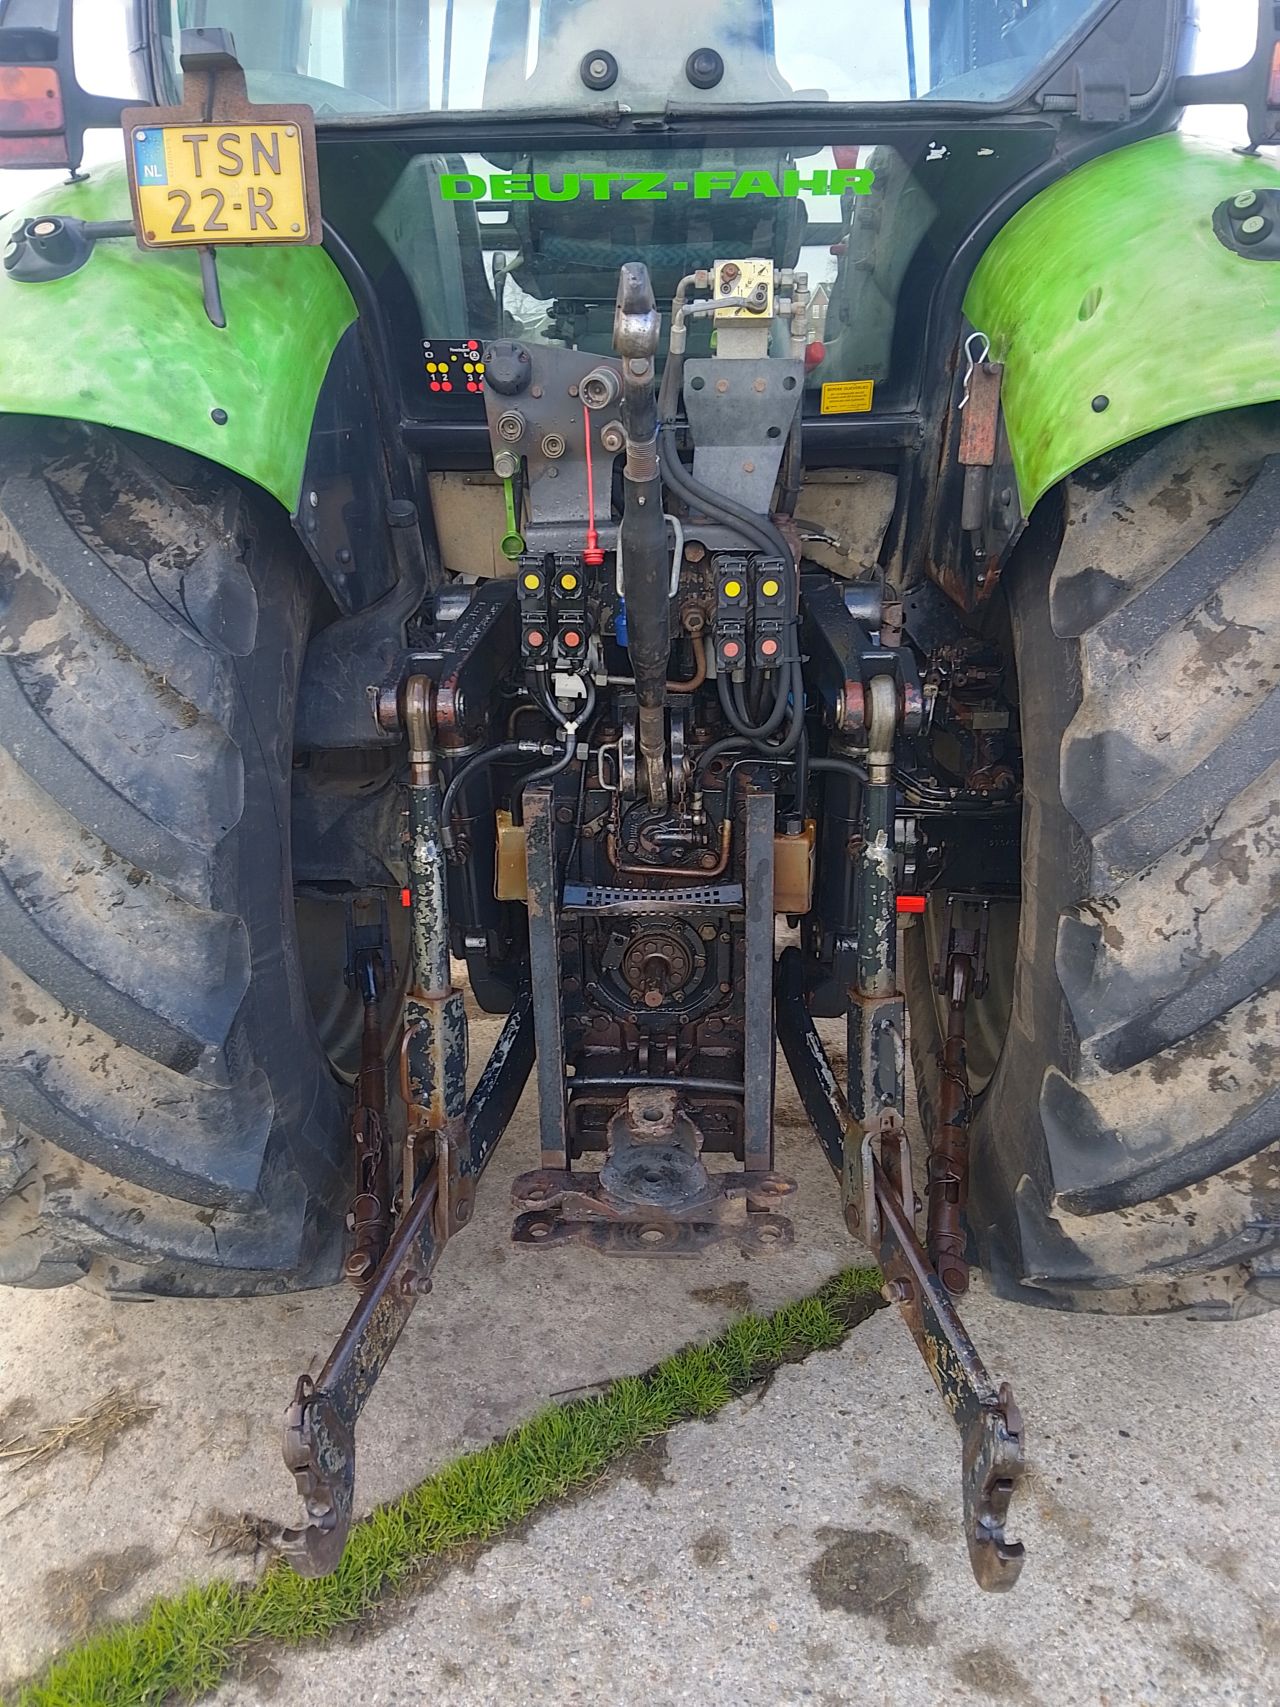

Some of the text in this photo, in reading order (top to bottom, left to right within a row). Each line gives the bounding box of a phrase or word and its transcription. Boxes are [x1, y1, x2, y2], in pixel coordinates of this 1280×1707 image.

[143, 164, 163, 178] NL
[182, 132, 282, 177] TSN
[439, 168, 875, 201] DEUTZ-FAHR
[167, 187, 278, 233] 22-R
[467, 374, 474, 382] 3
